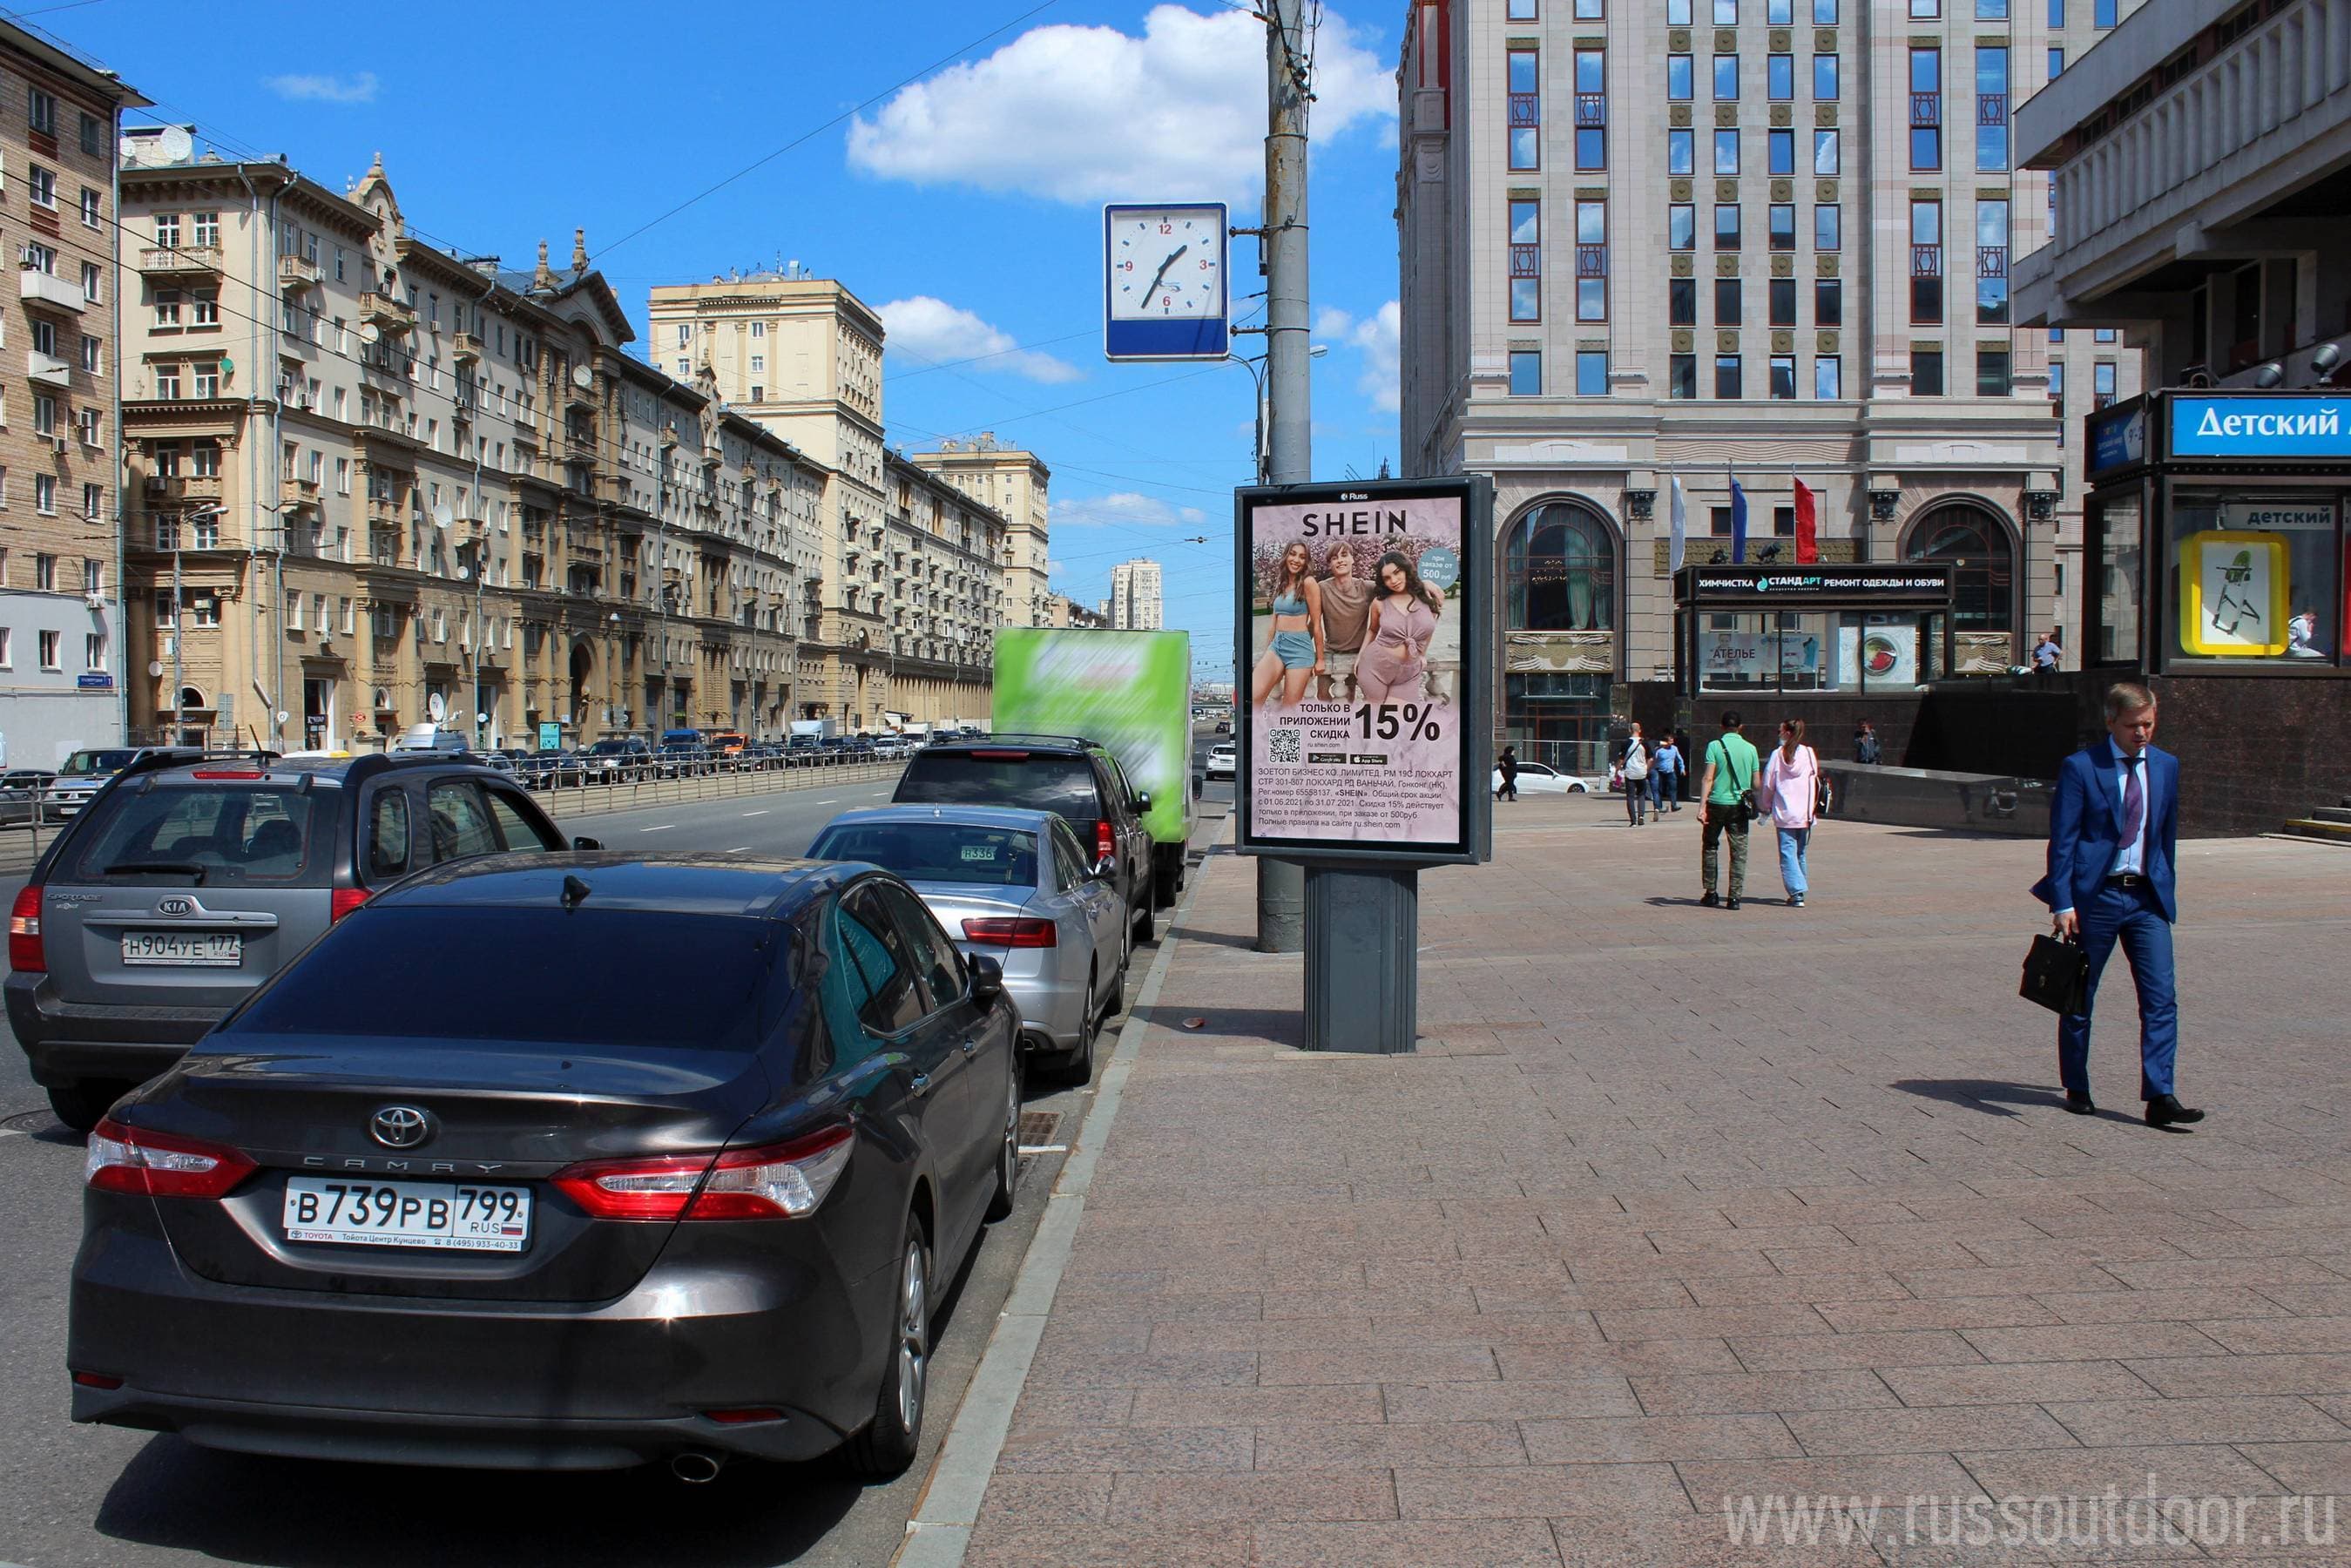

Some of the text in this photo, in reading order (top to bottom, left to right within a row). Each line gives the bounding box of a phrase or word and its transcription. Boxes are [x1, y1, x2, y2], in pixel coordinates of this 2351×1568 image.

[1159, 225, 1172, 234] 12
[1125, 260, 1133, 271] 9
[1199, 260, 1207, 270] 3
[1163, 296, 1171, 307] 6
[2196, 407, 2339, 436] Детский
[2247, 507, 2331, 525] детский
[1302, 510, 1407, 537] SHEIN
[1422, 569, 1440, 578] 500
[1768, 577, 1821, 586] СТАНДАРТ
[1824, 578, 1861, 587] РЕМОНТ
[1862, 578, 1903, 587] ОДЕЖДЫ
[1905, 578, 1913, 587] И
[1914, 578, 1944, 587] ОБУВИ
[1713, 648, 1756, 659] АТЕЛЬЕ
[1300, 704, 1350, 713] ТОЛЬКО В
[1280, 717, 1350, 726] ПРИЛОЖЕНИИ
[1355, 703, 1441, 740] 15%
[1310, 730, 1350, 740] СКИДКА
[1372, 789, 1399, 799] Общий
[1401, 791, 1417, 800] срок
[1359, 800, 1386, 808] Скидка
[1405, 801, 1444, 811] действует
[1258, 817, 1287, 826] Полные
[163, 902, 188, 912] KIA
[130, 935, 236, 956] Н904УЕ 177
[303, 1157, 503, 1174] CAMRY
[297, 1184, 519, 1230] В739РВ 799
[470, 1221, 501, 1234] RUS
[342, 1233, 368, 1241] Тойота
[368, 1234, 392, 1244] Центр
[393, 1236, 427, 1246] Кунцево
[476, 1240, 518, 1249] 933-40-33
